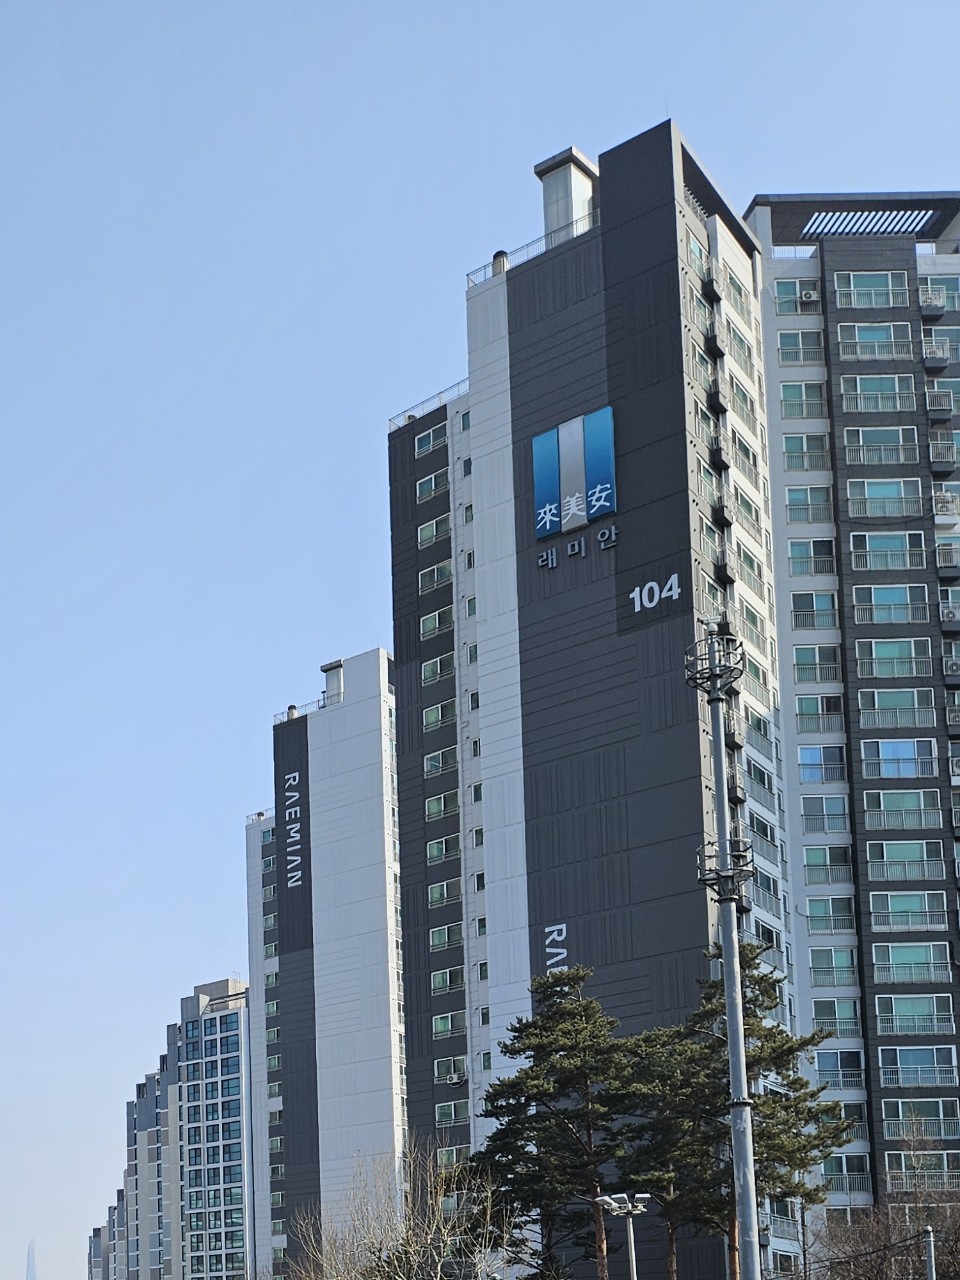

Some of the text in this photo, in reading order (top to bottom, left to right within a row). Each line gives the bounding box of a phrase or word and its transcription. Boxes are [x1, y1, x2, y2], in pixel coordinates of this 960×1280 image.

[538, 525, 618, 568] 래미안
[629, 573, 681, 613] 104
[284, 772, 302, 888] RAEMIAN
